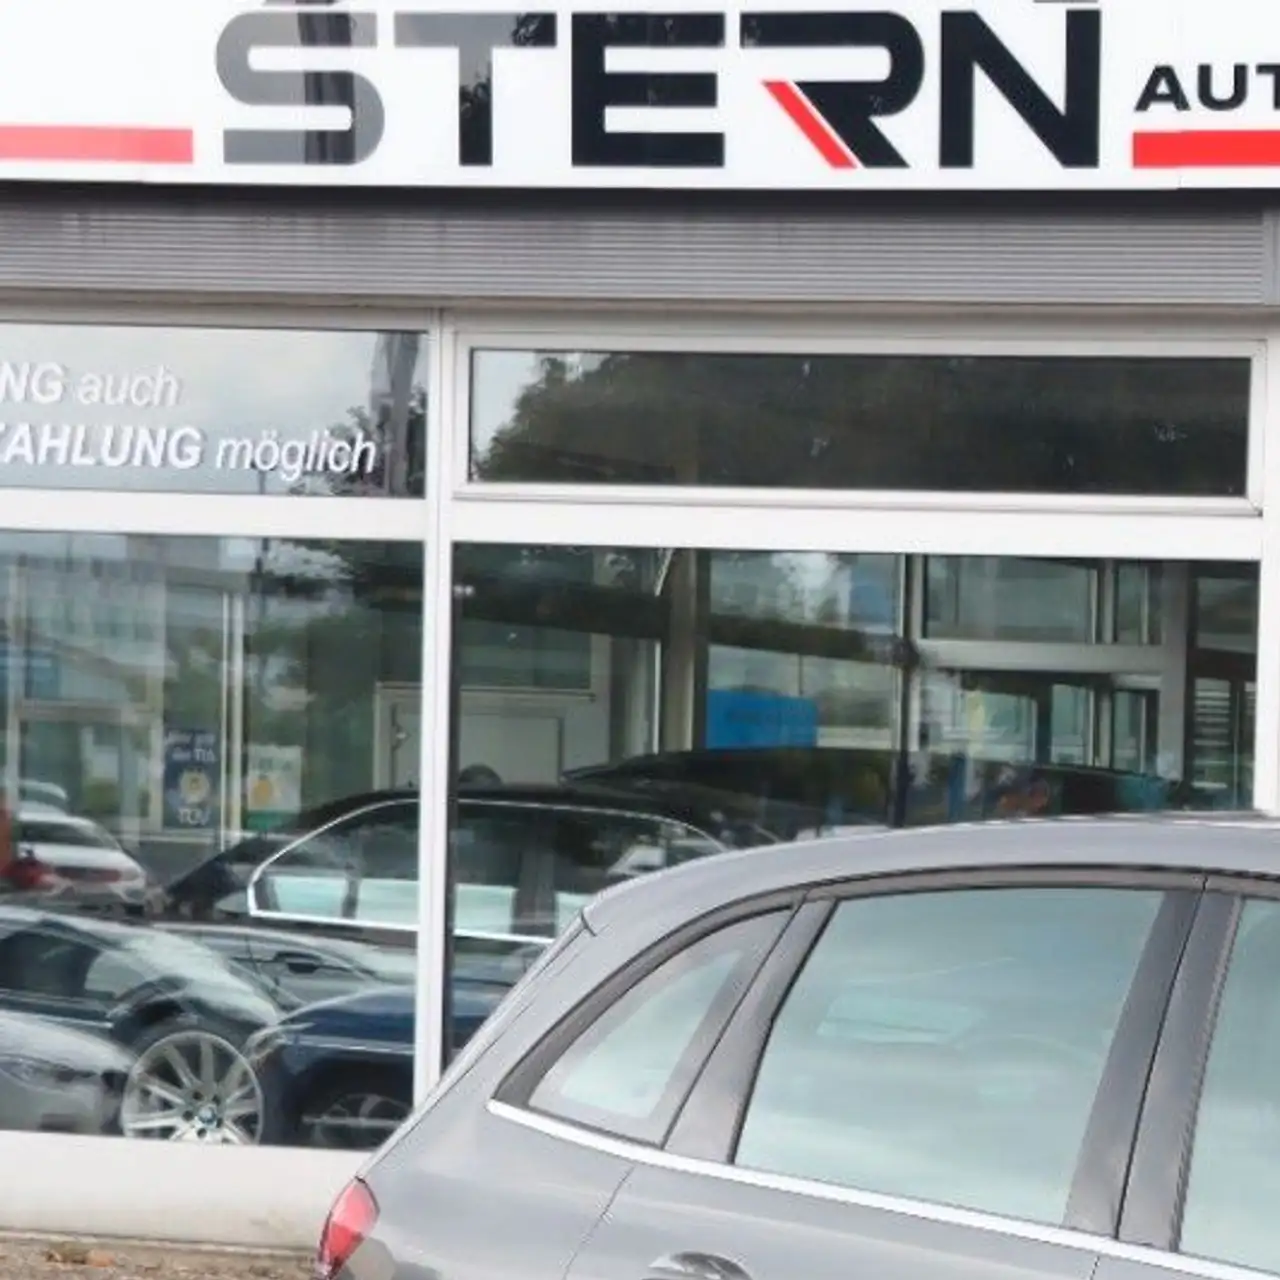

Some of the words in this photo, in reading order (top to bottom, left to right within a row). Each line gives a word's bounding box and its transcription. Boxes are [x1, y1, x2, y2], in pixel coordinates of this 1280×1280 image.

[214, 8, 1100, 169] STERN
[79, 365, 178, 407] auch
[0, 422, 203, 469] AHLUNG
[214, 428, 375, 481] möglich
